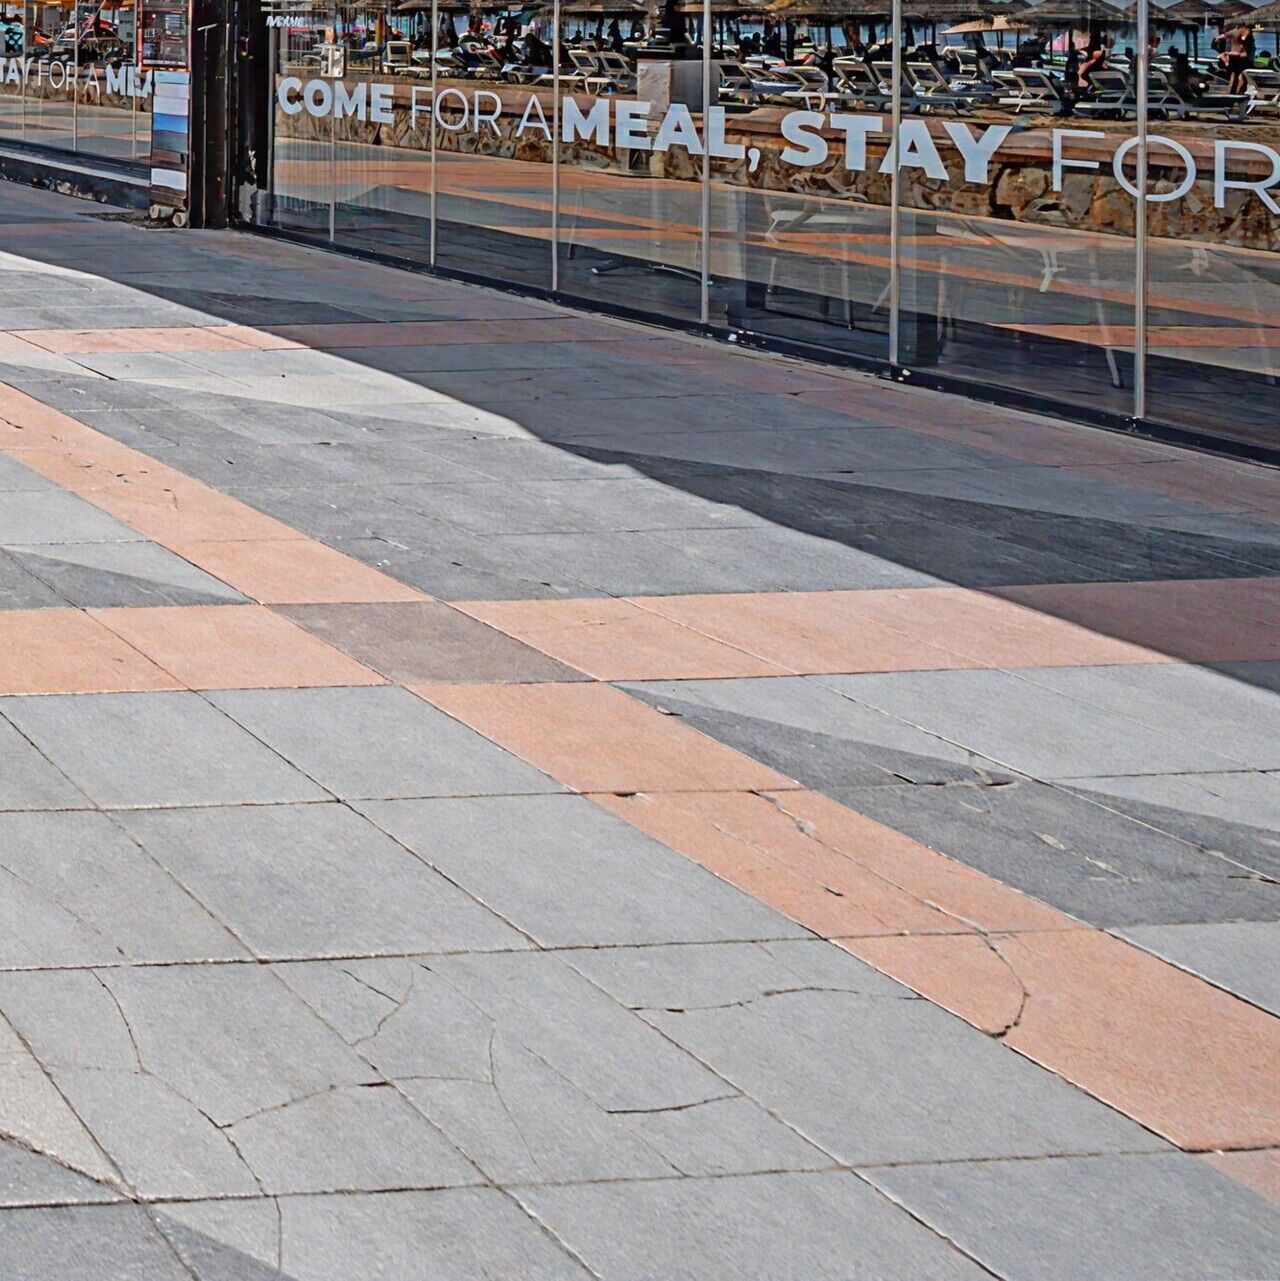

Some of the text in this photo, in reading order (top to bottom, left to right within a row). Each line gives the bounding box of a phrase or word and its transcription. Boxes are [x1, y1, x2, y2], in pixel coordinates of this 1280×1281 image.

[38, 59, 78, 91] FOR
[83, 62, 102, 104] A
[106, 63, 153, 99] MEA
[278, 76, 1280, 215] COME FOR A MEAL, STAY FOR
